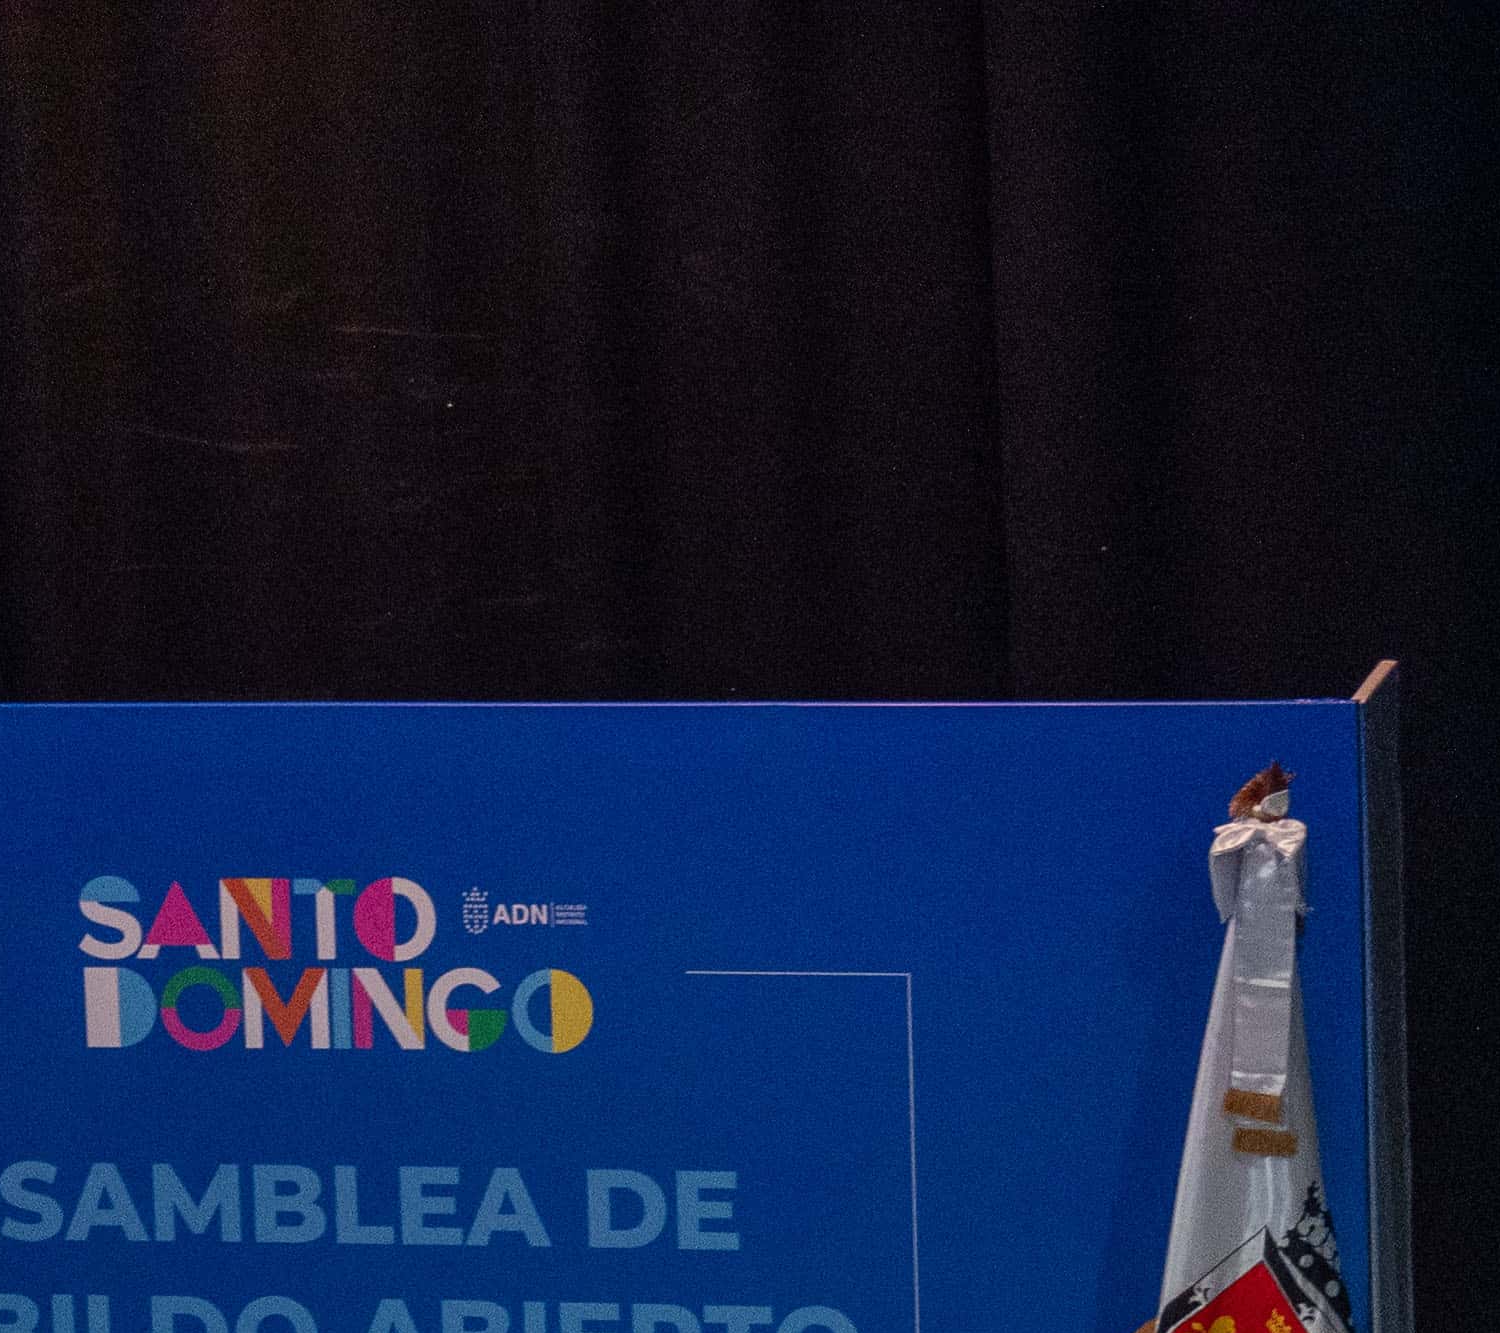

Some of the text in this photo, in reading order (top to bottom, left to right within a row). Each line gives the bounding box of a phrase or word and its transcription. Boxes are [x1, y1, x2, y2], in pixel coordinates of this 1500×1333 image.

[78, 875, 437, 962] SANTO
[493, 903, 549, 926] ADN
[83, 966, 594, 1053] DOMINGO
[586, 1168, 741, 1251] DE
